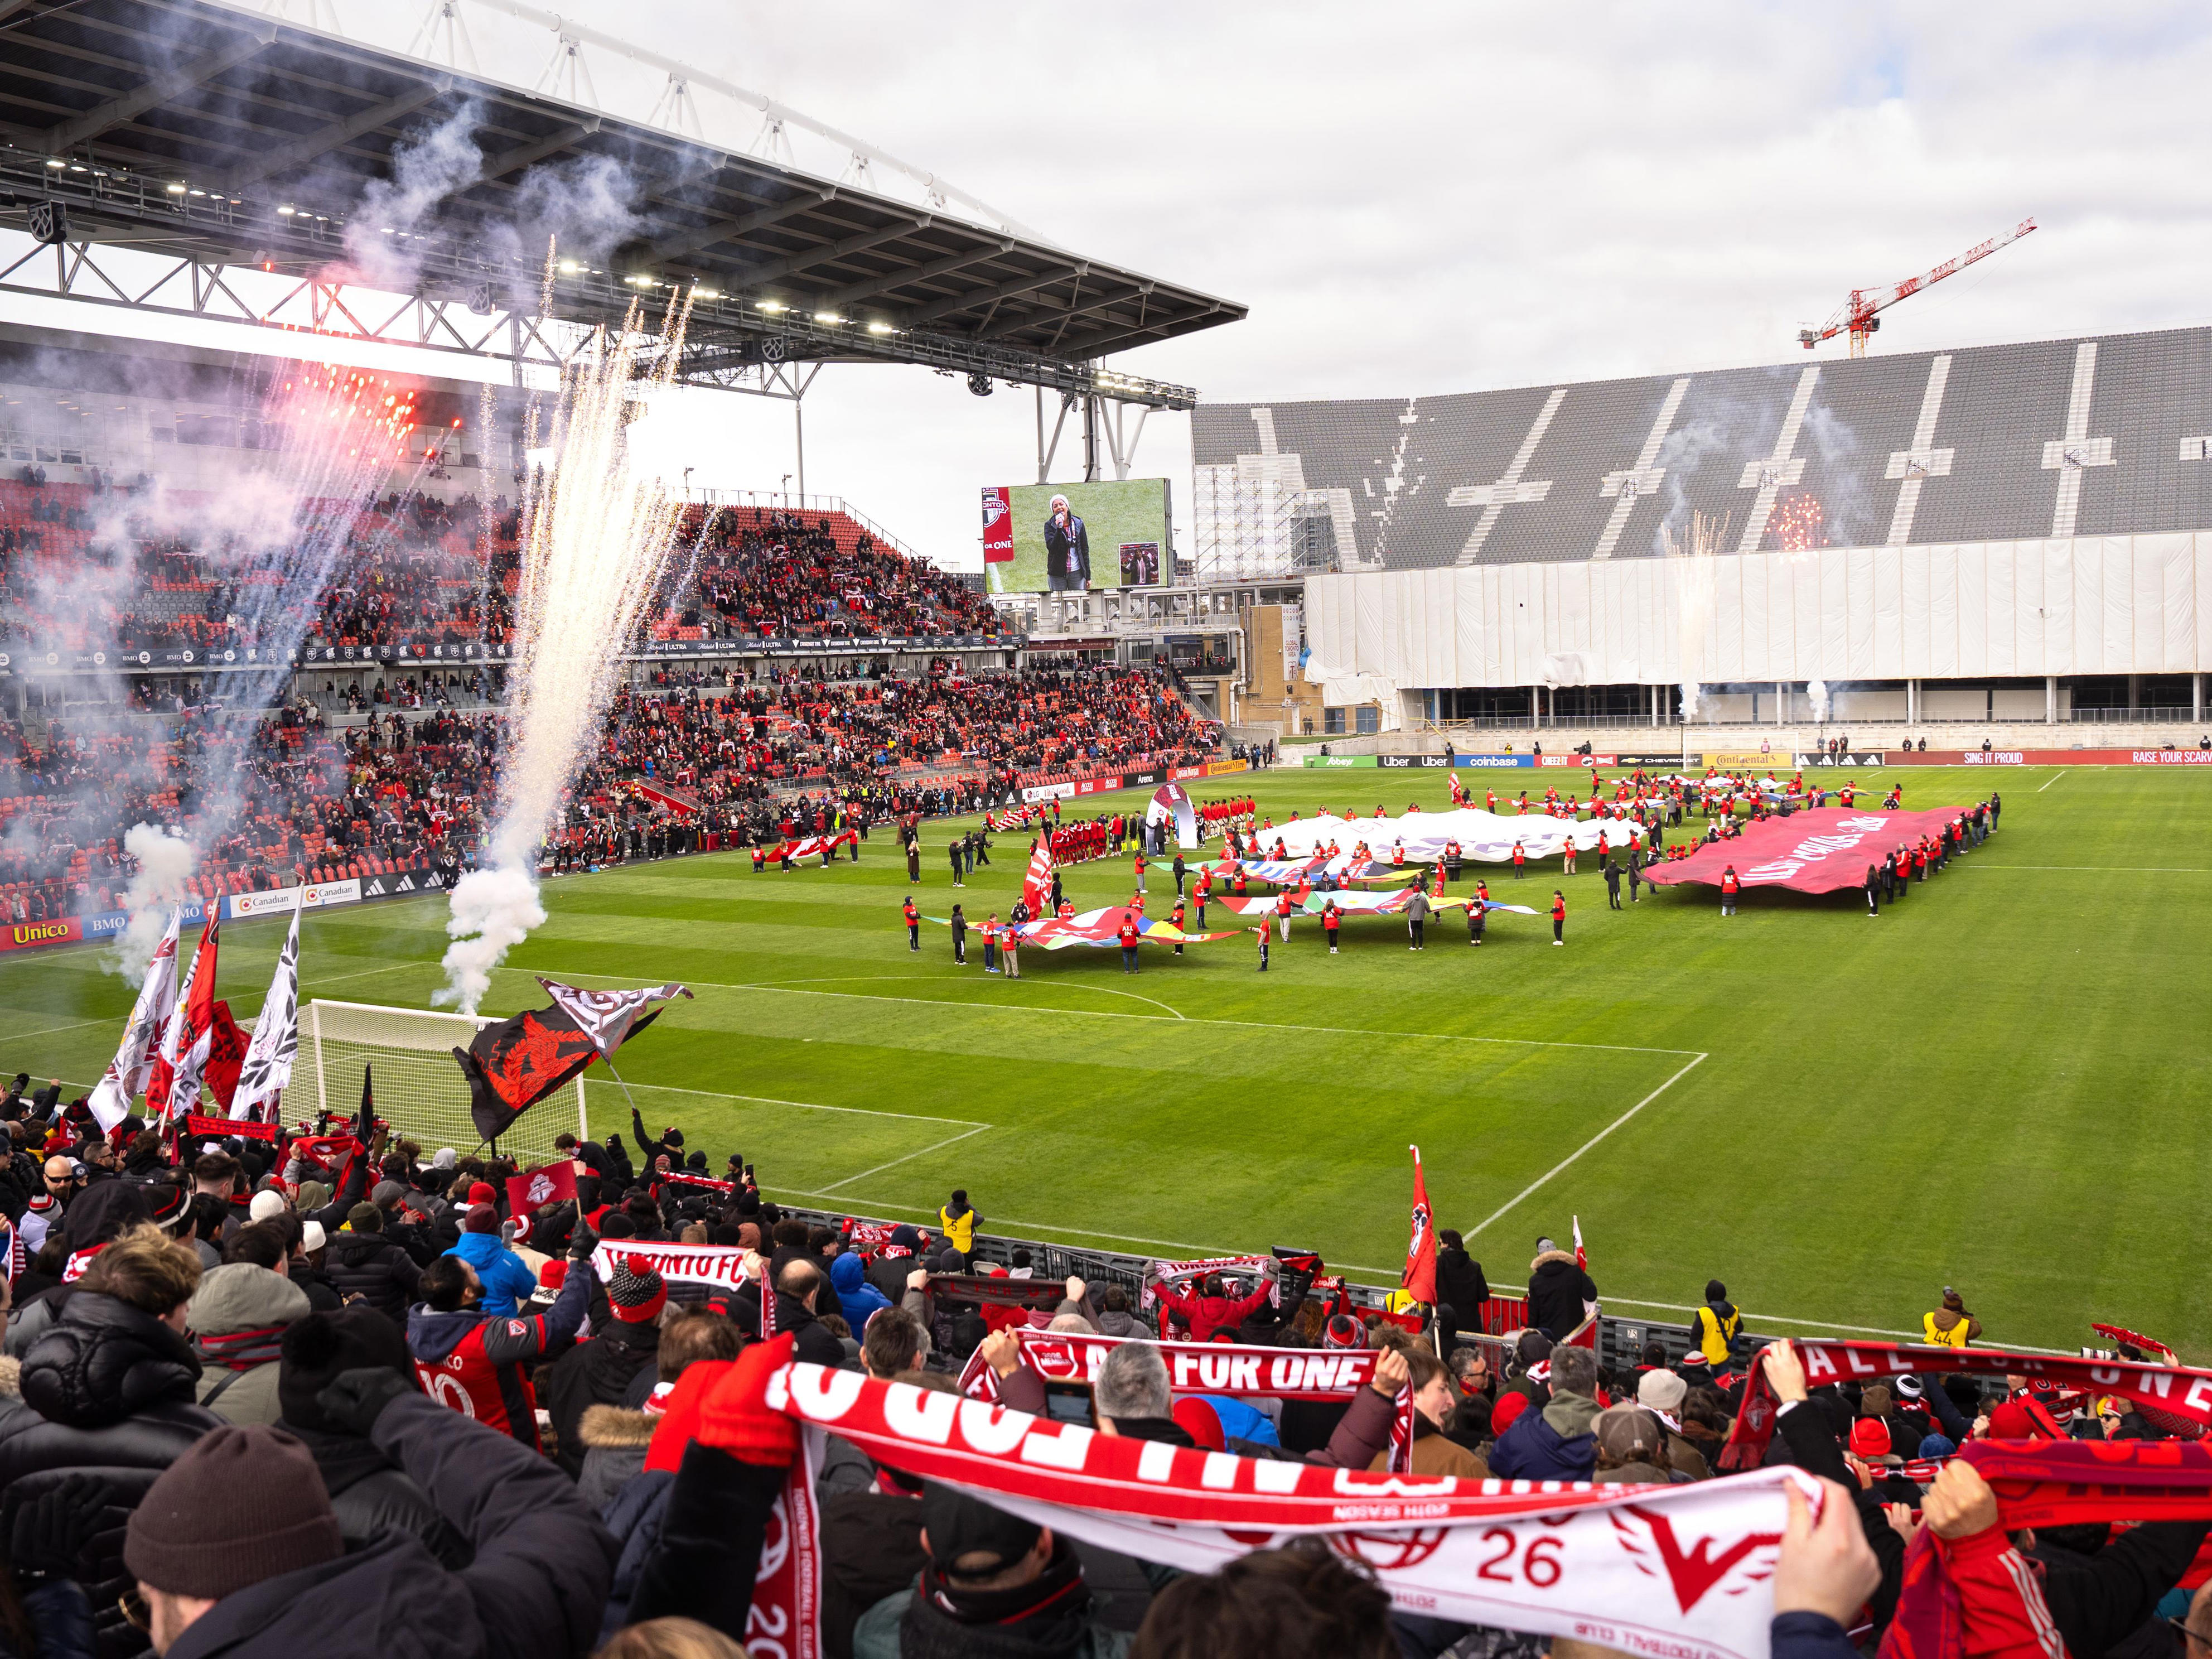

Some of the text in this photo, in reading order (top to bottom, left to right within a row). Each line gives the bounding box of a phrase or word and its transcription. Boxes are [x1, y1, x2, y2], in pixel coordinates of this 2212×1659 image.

[993, 540, 1013, 549] ONE
[1384, 757, 1409, 766] Uber
[1422, 757, 1448, 766] Uber
[1470, 756, 1518, 766] coinbase
[1716, 754, 1768, 765] Continental
[1964, 752, 2023, 764] SING IT PROUD
[2133, 751, 2158, 763] RAISE
[2160, 751, 2182, 763] YOUR
[1211, 764, 1232, 774] Continental
[1137, 775, 1153, 784] Arena
[319, 886, 352, 898] Canadian
[253, 894, 289, 907] Canadian
[93, 917, 125, 932] BMO
[13, 923, 69, 944] Unico
[1934, 1329, 1953, 1346] 44
[1040, 1357, 1071, 1366] MEMBER
[1806, 1345, 1914, 1378] ALL
[1174, 1352, 1370, 1392] FOR ONE
[419, 1369, 475, 1420] 10
[1477, 1527, 1563, 1588] 26
[800, 1550, 813, 1620] FOOTBALL
